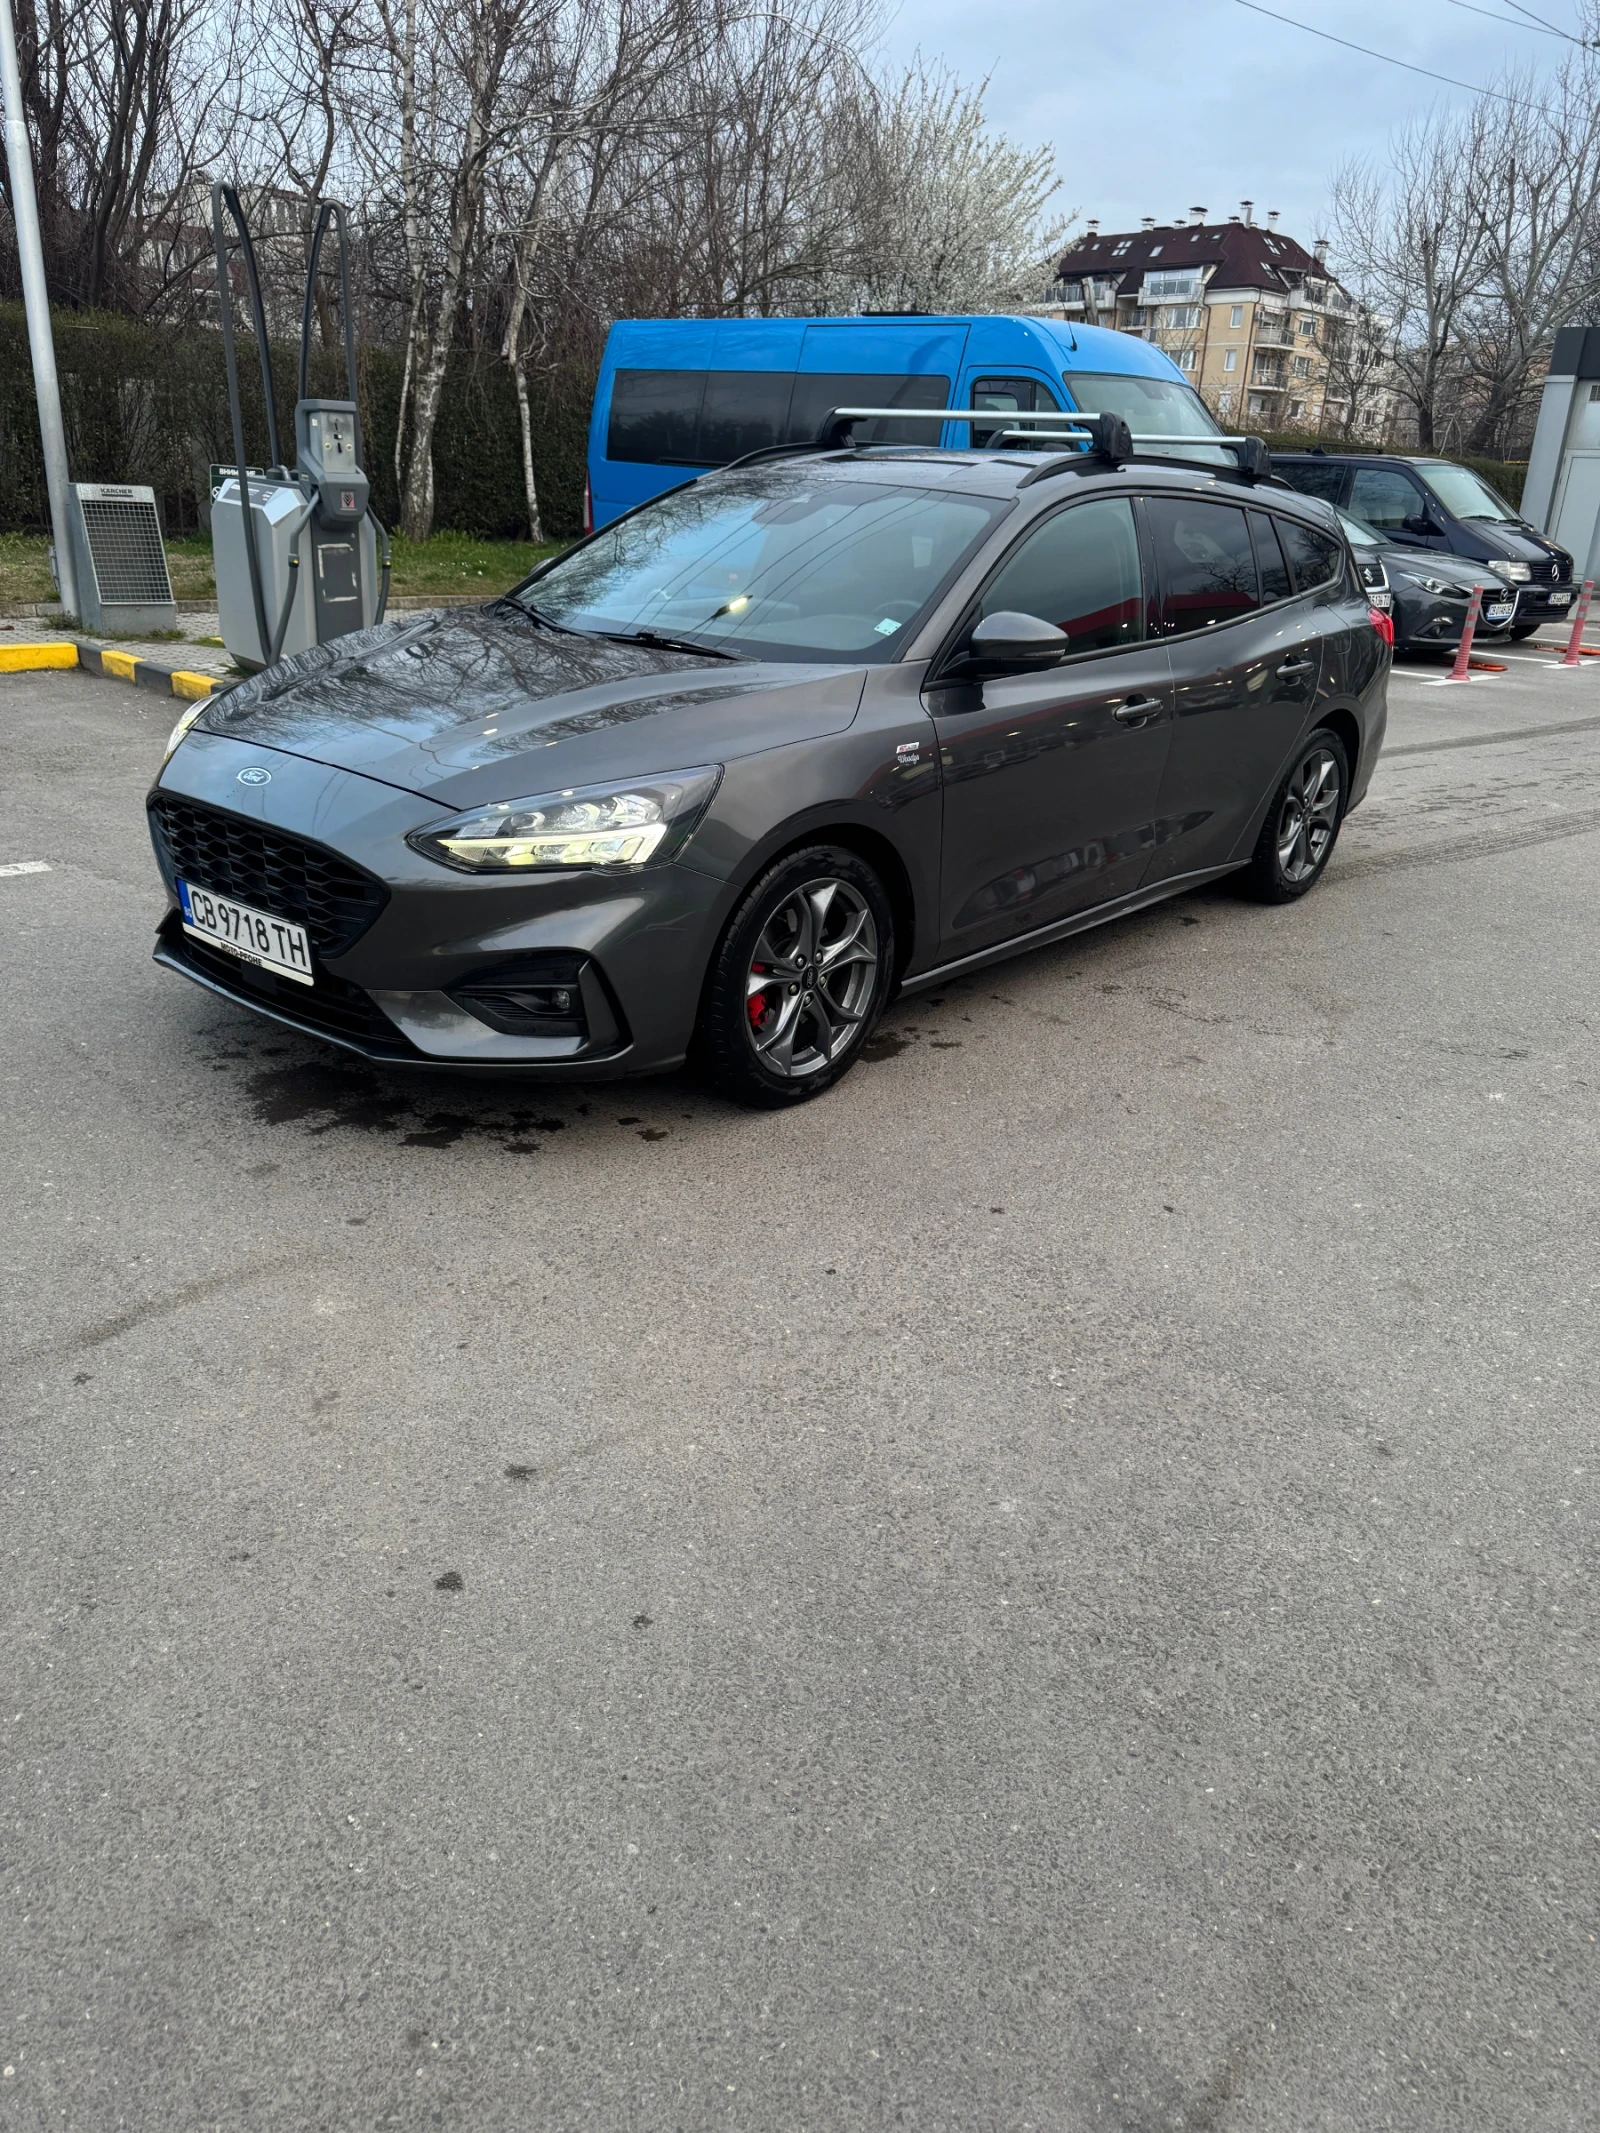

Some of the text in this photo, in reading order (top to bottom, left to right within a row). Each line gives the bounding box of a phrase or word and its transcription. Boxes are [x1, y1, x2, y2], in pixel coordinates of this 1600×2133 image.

[219, 468, 256, 476] ВНИМИЕ
[191, 890, 307, 967] CB 9718 TH
